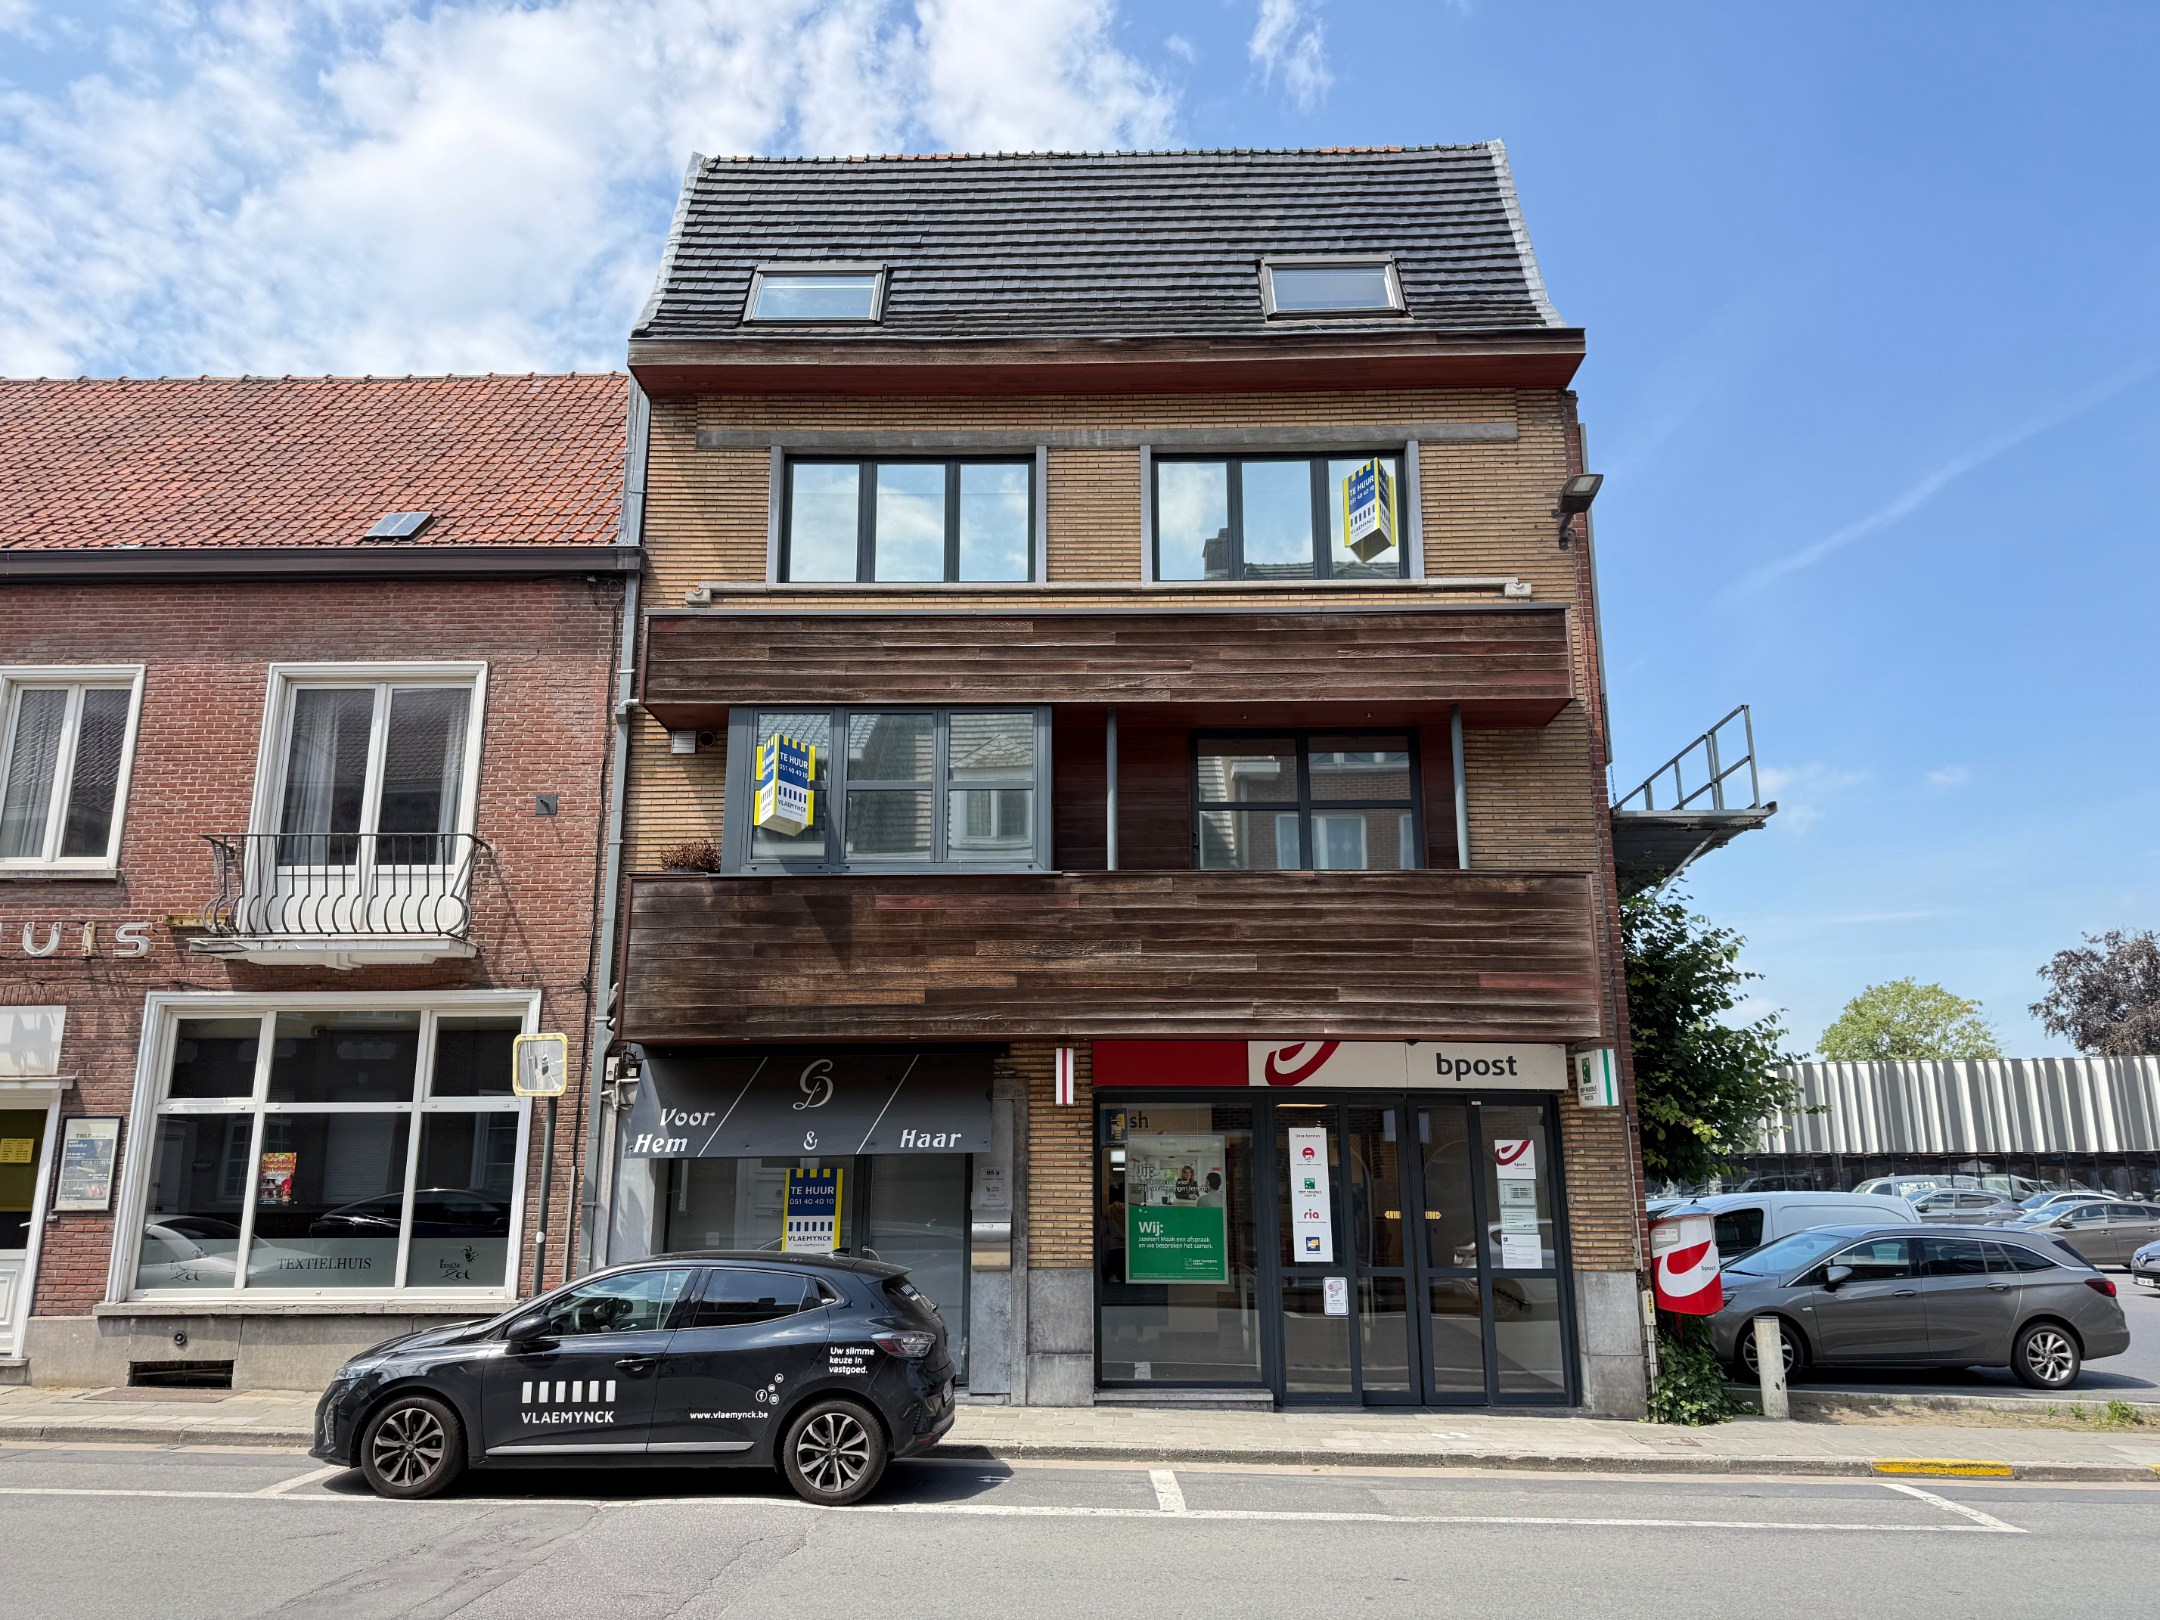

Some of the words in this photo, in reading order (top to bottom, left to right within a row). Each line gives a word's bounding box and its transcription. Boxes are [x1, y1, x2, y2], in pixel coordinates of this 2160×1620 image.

[1349, 486, 1357, 497] TE
[1357, 475, 1374, 492] HUUR
[780, 752, 788, 762] TE
[789, 755, 808, 770] HUUR
[778, 798, 806, 813] VLAEMYNCK
[0, 921, 152, 958] UIS
[1435, 1052, 1518, 1081] bpost
[659, 1107, 716, 1127] Voor
[633, 1133, 688, 1153] Hem
[803, 1130, 818, 1150] &
[899, 1128, 962, 1148] Haar
[790, 1186, 803, 1195] TE
[805, 1186, 835, 1195] HUUR
[1304, 1208, 1319, 1219] ria
[1138, 1221, 1164, 1236] Wij:
[277, 1257, 372, 1270] TEXTIELHUIS
[830, 1347, 844, 1355] Uw
[845, 1346, 875, 1355] slimme
[829, 1356, 853, 1364] keuze
[854, 1356, 862, 1364] in
[829, 1366, 868, 1375] vastgoed.
[521, 1410, 615, 1424] VLAEMYNCK
[689, 1410, 769, 1420] www.vlaemynck.be
